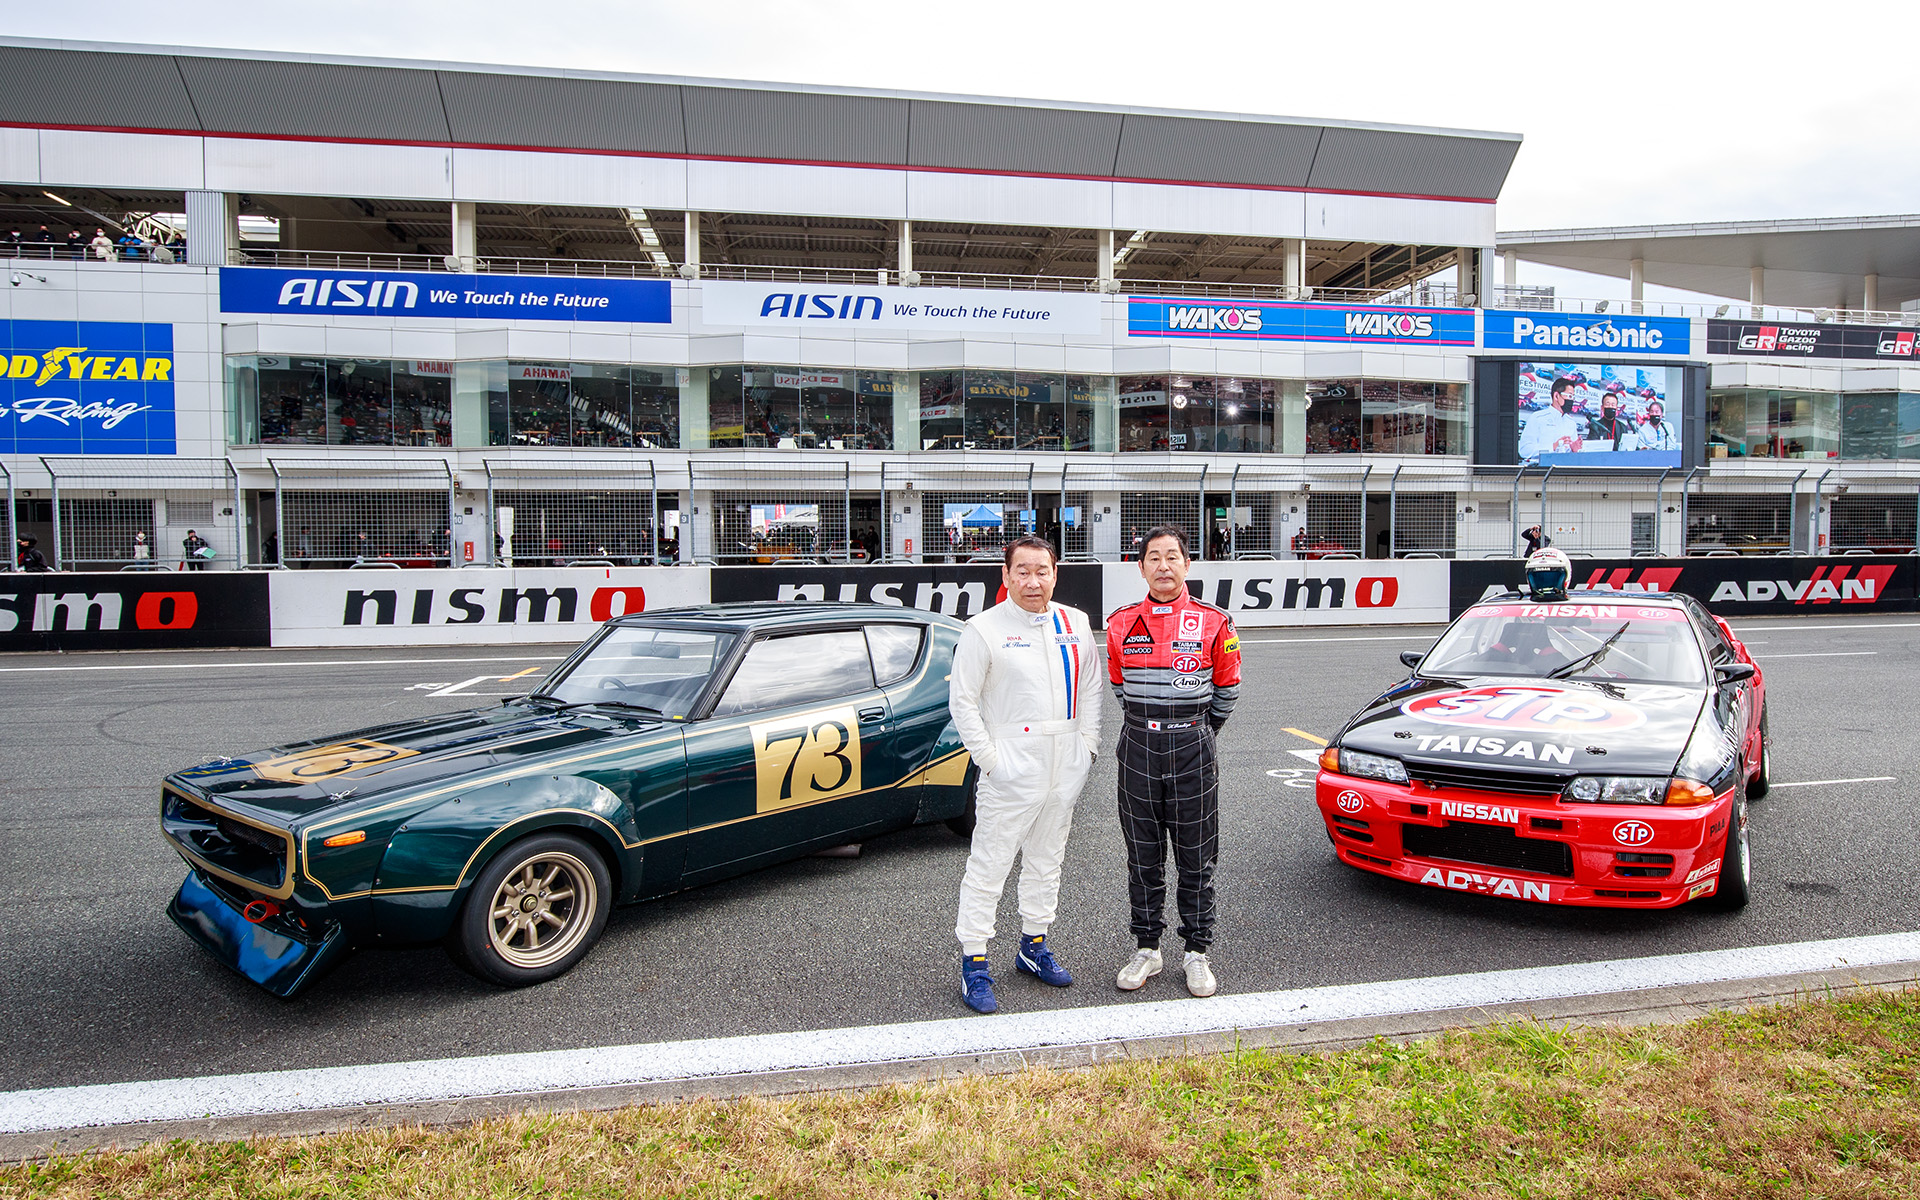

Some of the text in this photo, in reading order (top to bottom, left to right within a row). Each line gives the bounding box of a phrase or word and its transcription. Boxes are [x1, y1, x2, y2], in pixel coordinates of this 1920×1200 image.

[277, 279, 609, 309] AISIN We Touch the Future
[760, 293, 1051, 321] AISIN We Touch the Future
[1168, 305, 1263, 331] WAKO'S
[1345, 311, 1433, 337] WAKO'S
[1513, 317, 1663, 349] Panasonic
[1779, 335, 1817, 344] GAZOO
[1781, 327, 1821, 337] TOYOTA
[1740, 335, 1776, 350] GR
[1777, 343, 1815, 353] Racing
[1878, 340, 1914, 355] GR
[12, 397, 152, 430] Racing
[681, 515, 687, 523] 9
[777, 582, 1008, 615] nism
[1709, 578, 1875, 602] ADVAN
[343, 586, 646, 626] nismo
[1479, 607, 1501, 616] STP
[1521, 605, 1617, 618] TAISAN
[1641, 609, 1666, 618] STP
[1055, 635, 1079, 643] NISSAN
[1126, 635, 1151, 643] ADVAN
[1124, 647, 1152, 655] KENWOOD
[1176, 657, 1197, 671] STP
[1176, 678, 1197, 687] Arai
[1422, 688, 1611, 725] STP
[1416, 734, 1575, 765] TAISAN
[763, 720, 853, 801] 73
[1340, 792, 1360, 810] STP
[1441, 801, 1519, 824] NISSAN
[1617, 823, 1650, 842] STP
[1420, 867, 1550, 902] ADVAN
